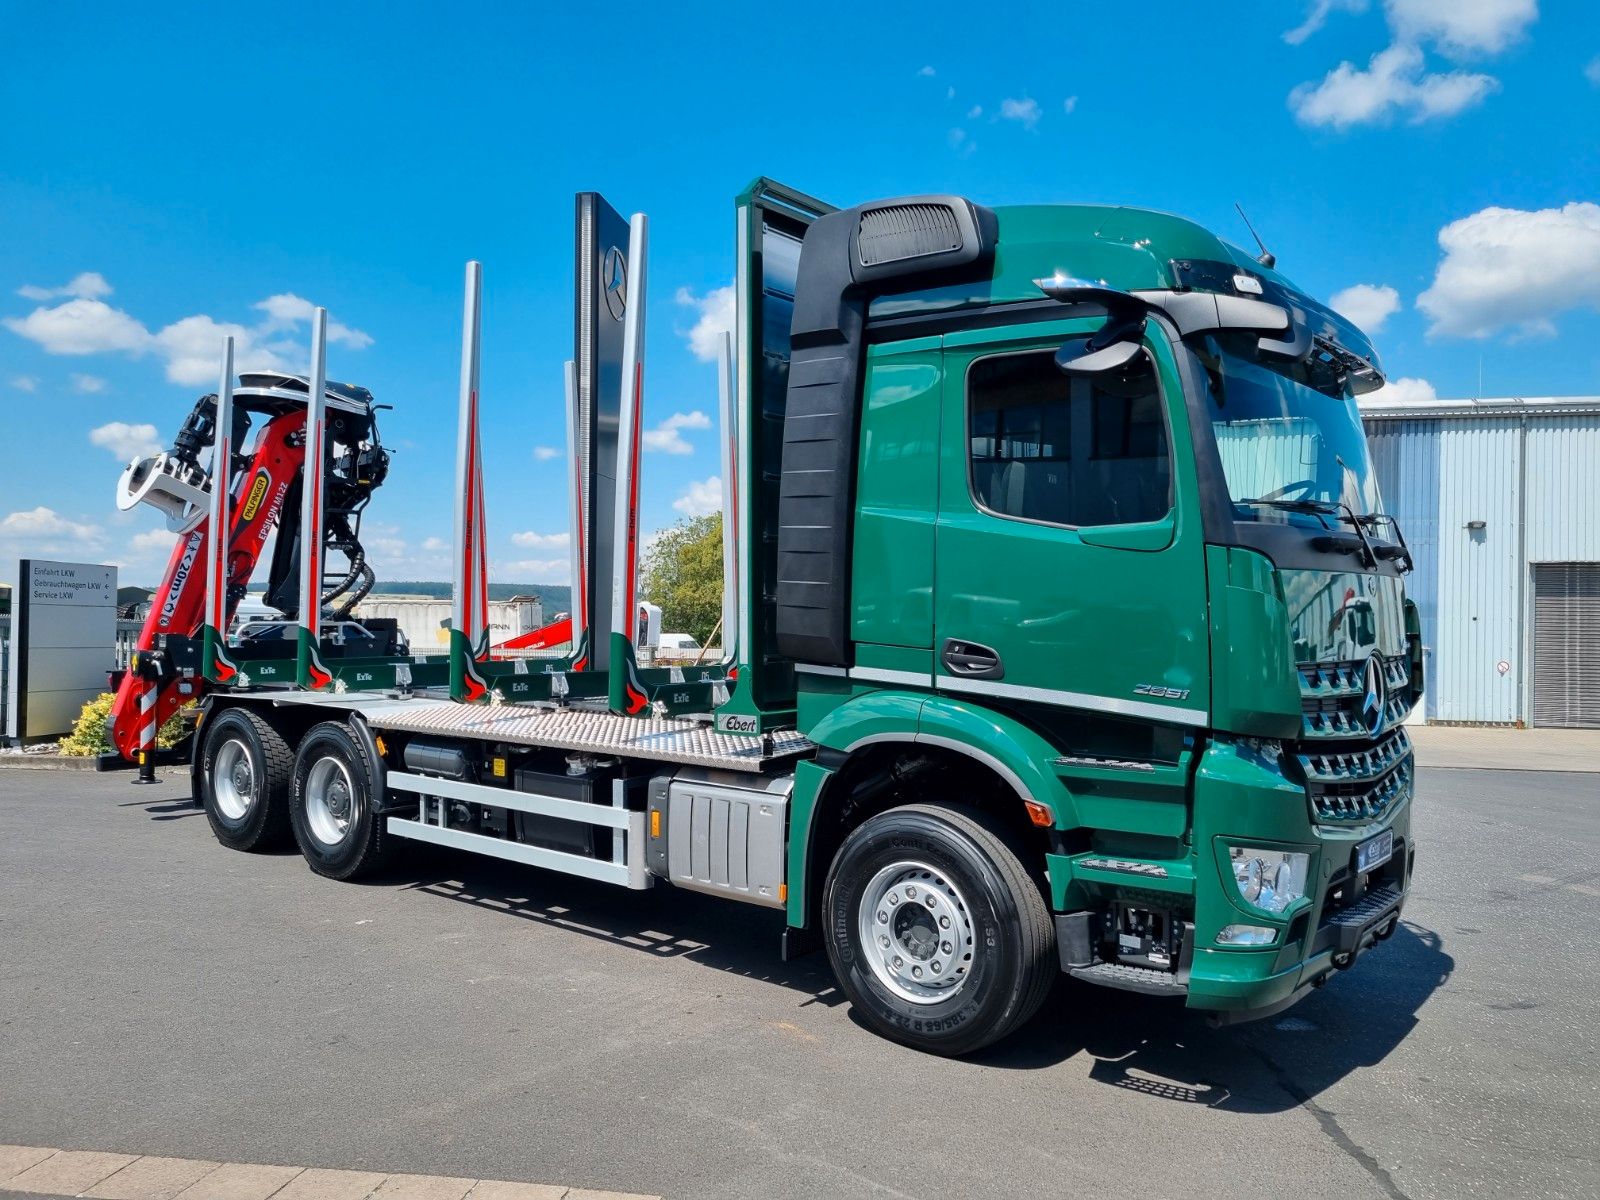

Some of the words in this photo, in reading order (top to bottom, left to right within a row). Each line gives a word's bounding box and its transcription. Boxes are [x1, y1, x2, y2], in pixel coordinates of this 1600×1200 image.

[244, 479, 265, 518] PALFINGER
[259, 505, 278, 540] EPSILON
[274, 482, 288, 505] M12Z
[34, 567, 59, 576] Einfahrt
[60, 569, 76, 578] LKW
[34, 579, 87, 591] Gebrauchtwagen
[87, 582, 102, 590] LKW
[33, 590, 58, 599] Service
[59, 592, 74, 600] LKW
[260, 667, 276, 675] ExTe
[356, 673, 373, 681] ExTe
[512, 682, 529, 692] ExTe
[673, 693, 690, 703] ExTe
[726, 715, 756, 732] Ebert
